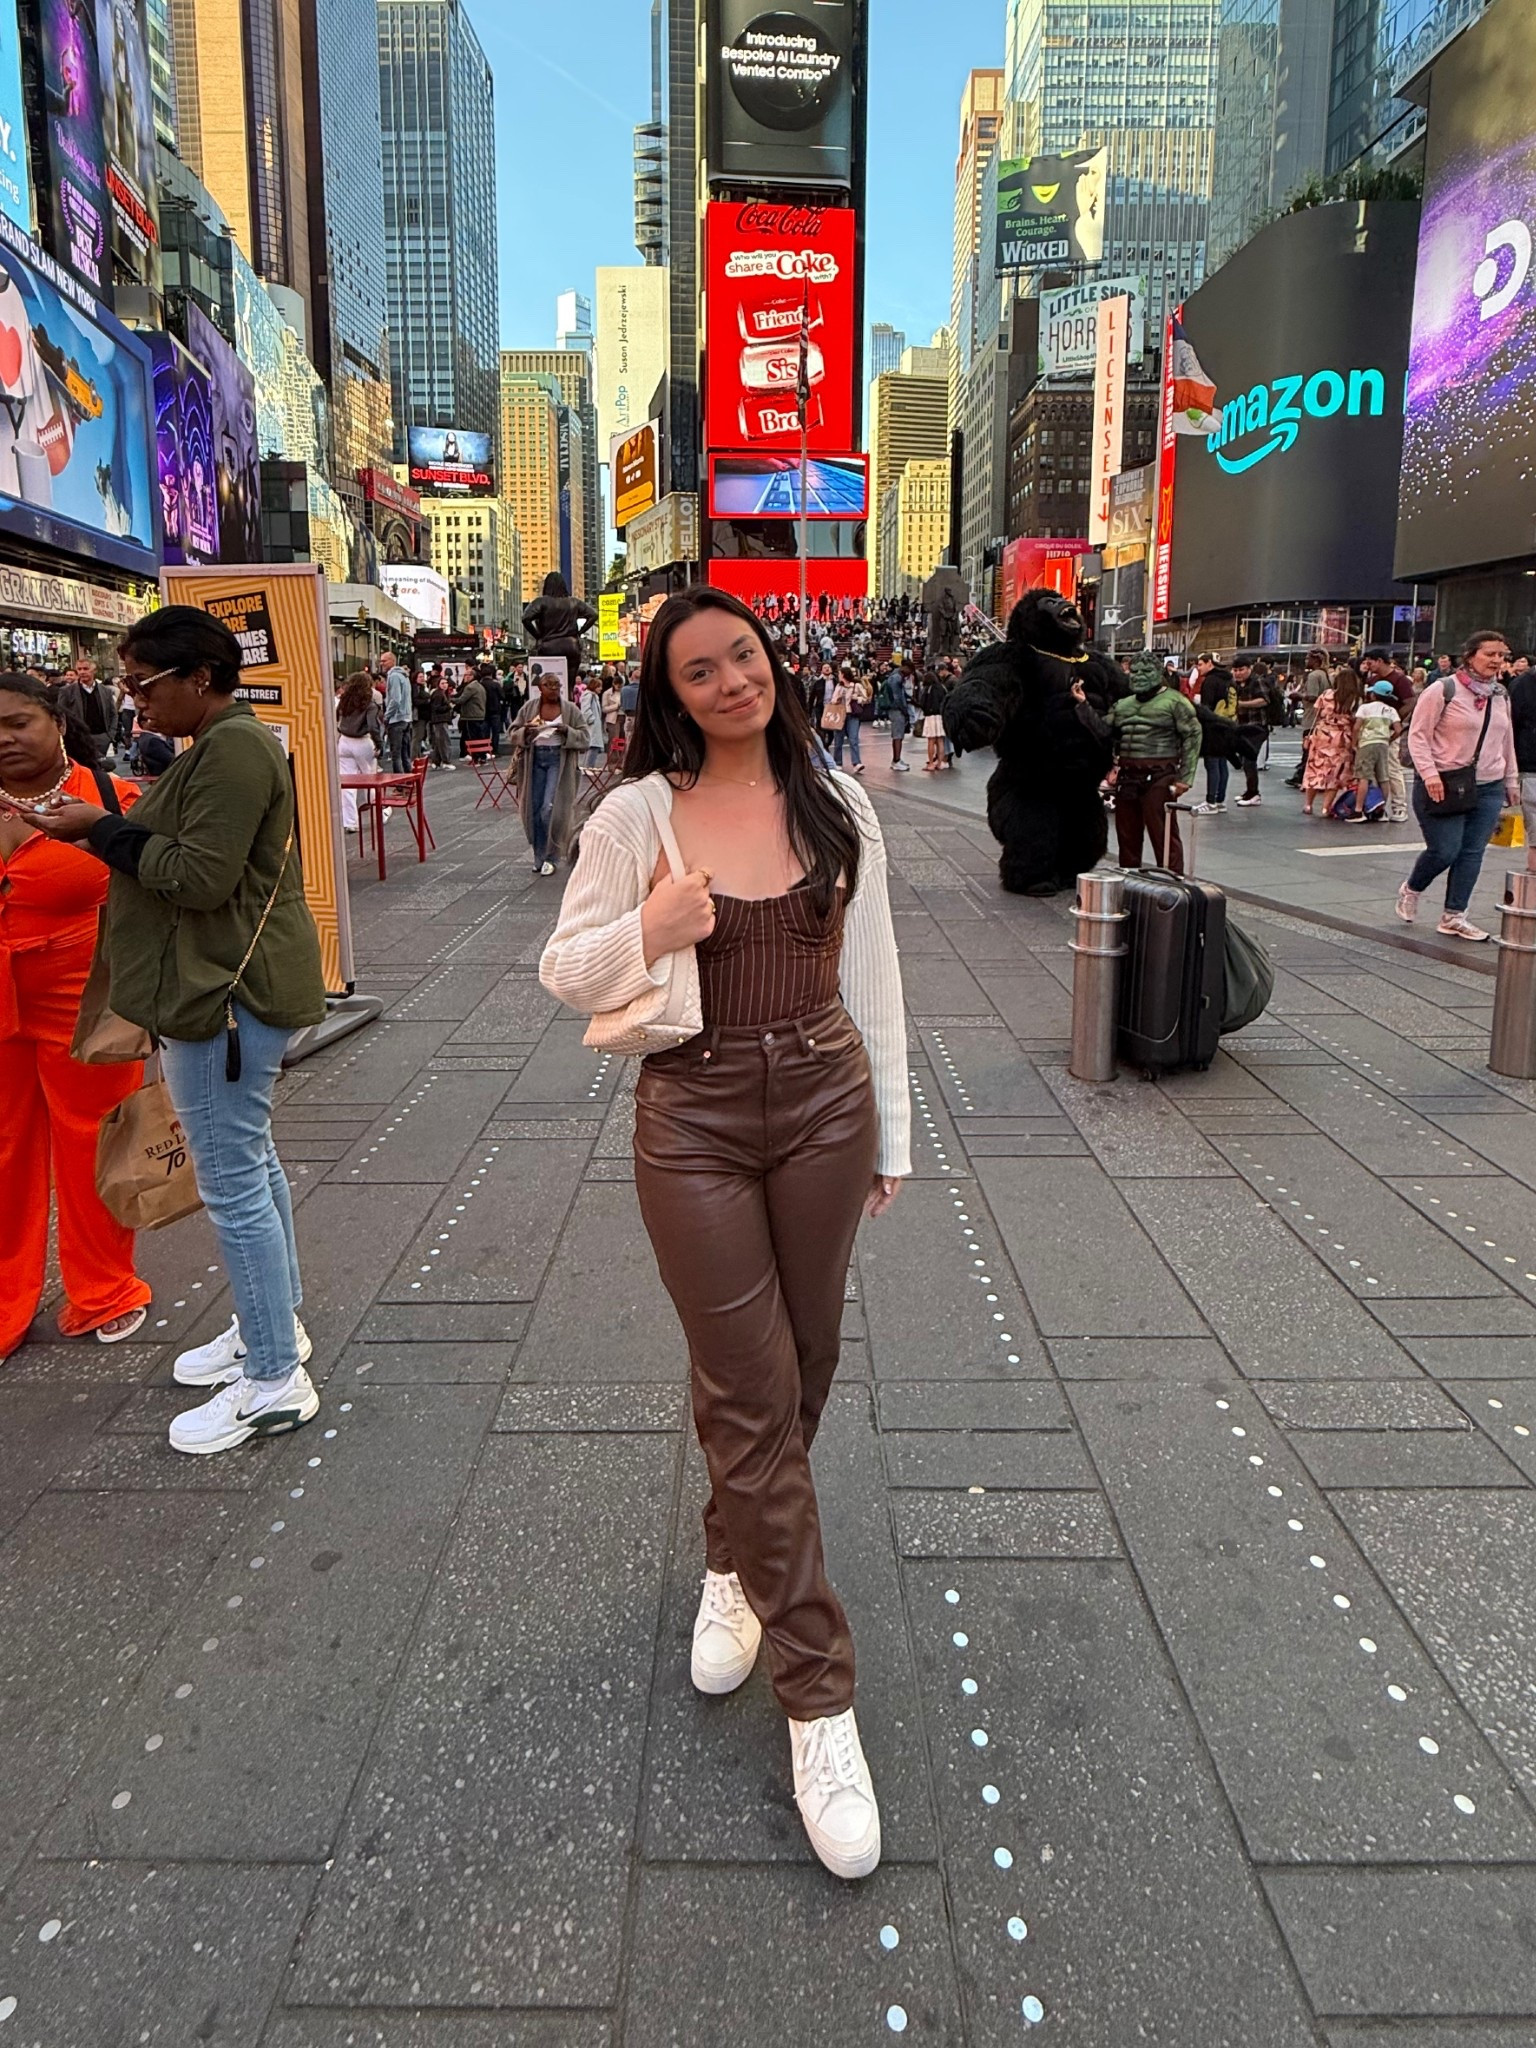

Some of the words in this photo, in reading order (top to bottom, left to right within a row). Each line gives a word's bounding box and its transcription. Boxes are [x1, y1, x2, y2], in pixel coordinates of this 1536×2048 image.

[747, 32, 816, 51] Introducing
[722, 47, 775, 63] Bespoke
[776, 51, 788, 63] AI
[790, 52, 840, 69] Laundry
[732, 63, 775, 78] Vented
[1005, 217, 1038, 229] Brains.
[1040, 213, 1069, 225] Heart.
[1016, 226, 1057, 237] Courage.
[0, 213, 29, 257] RAND
[30, 242, 55, 282] SLAM
[56, 261, 75, 300] NEW
[75, 281, 97, 318] YORK
[751, 252, 763, 260] will
[764, 253, 777, 261] you
[728, 261, 763, 273] share
[766, 261, 774, 271] a
[814, 273, 832, 281] with?
[1049, 286, 1097, 318] LITTLE
[618, 285, 628, 343] Jedrzejewski
[767, 358, 798, 382] Sis
[1101, 311, 1116, 496] LICENSED
[762, 411, 800, 431] Bro
[411, 468, 458, 482] SUNSET
[460, 472, 491, 486] BLVD.
[680, 496, 694, 559] HELLO!
[0, 566, 52, 610] GRAND
[50, 578, 88, 616] SLAM
[207, 594, 264, 619] EXPLORE
[222, 615, 248, 632] ORE
[240, 646, 269, 666] ARE
[232, 688, 250, 699] 6TH
[250, 688, 279, 700] STREET
[144, 1139, 173, 1159] RED
[175, 1133, 187, 1146] L
